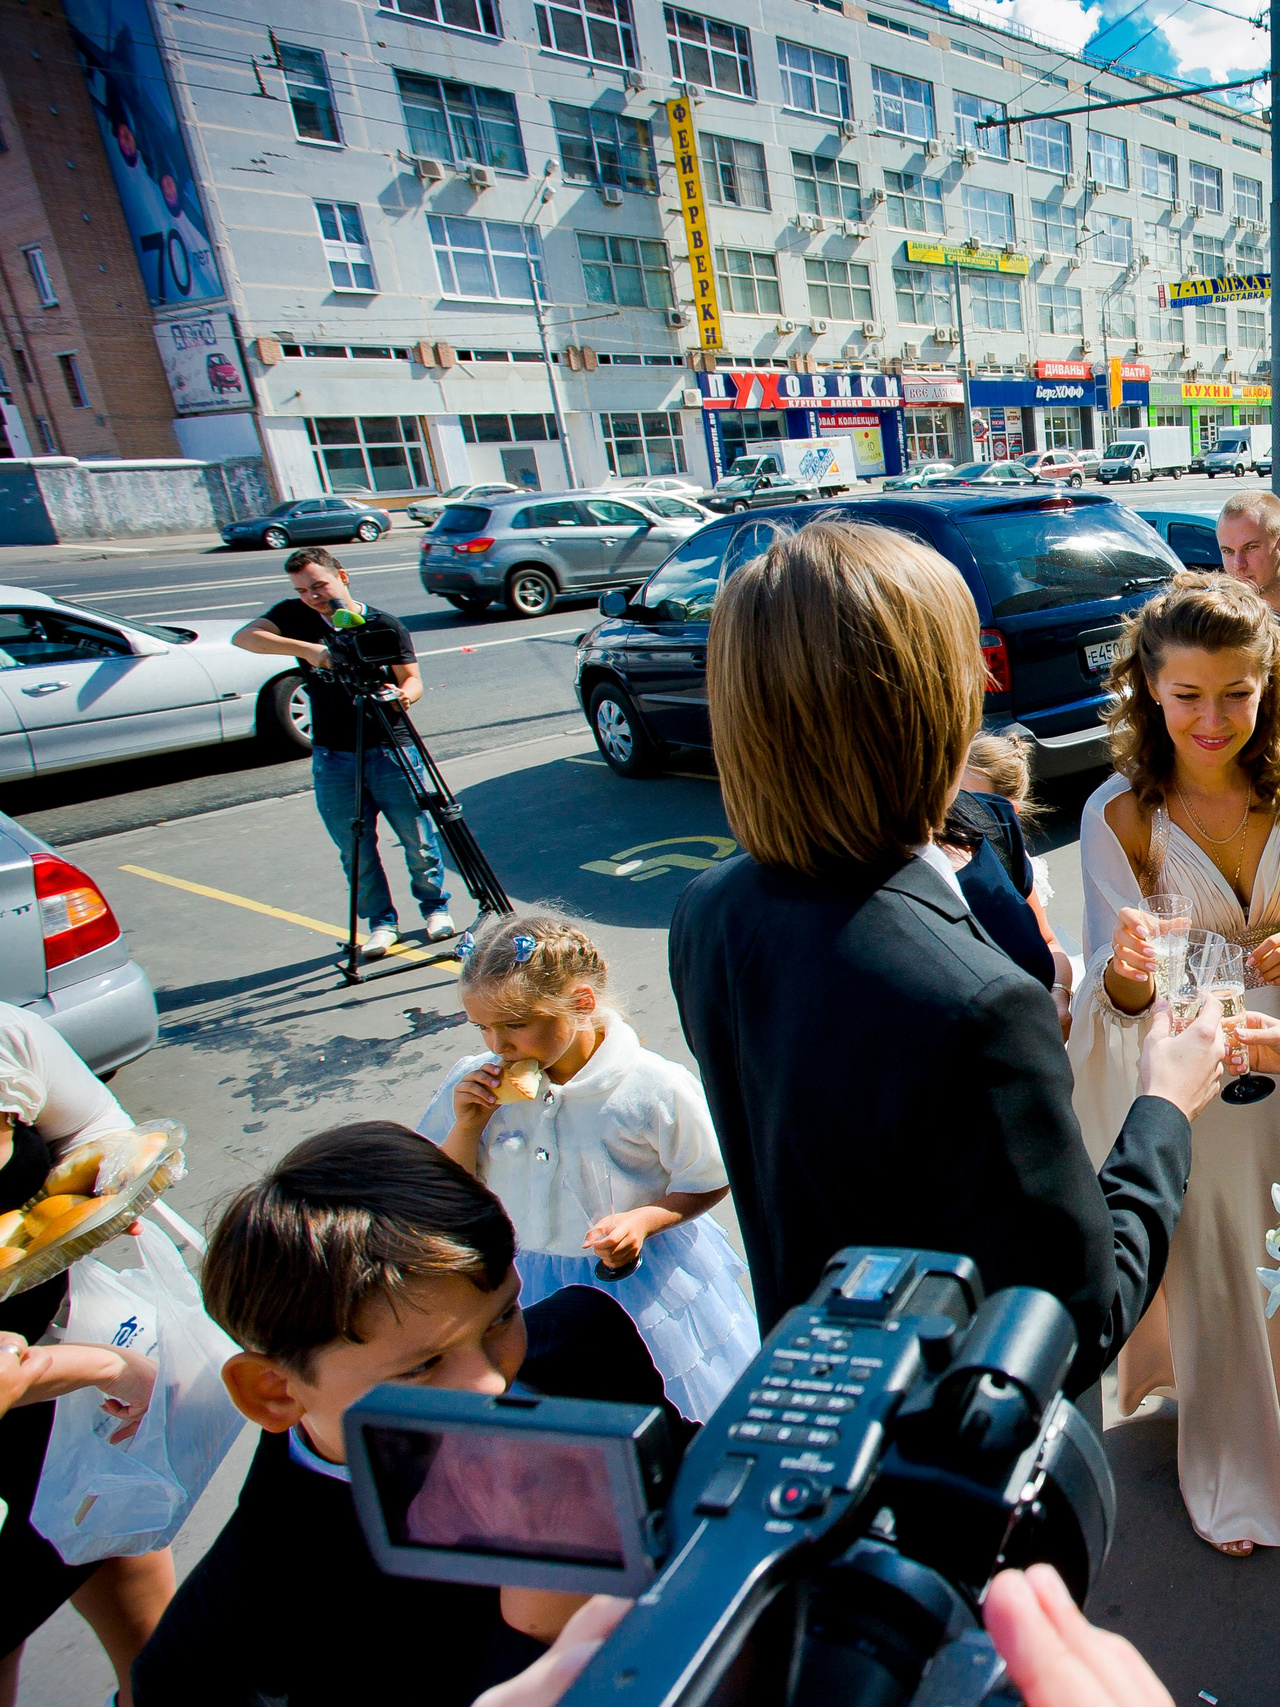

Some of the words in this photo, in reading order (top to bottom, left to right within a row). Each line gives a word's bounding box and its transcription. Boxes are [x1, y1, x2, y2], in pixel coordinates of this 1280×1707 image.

[672, 103, 717, 345] ФЕЙЕРВЕРКИ
[912, 242, 939, 251] ДВЕРИ
[941, 246, 973, 256] ПЛИТКА
[976, 251, 1004, 260] ПАРКЕТ
[140, 228, 192, 305] 70
[1217, 274, 1265, 294] МЕХА
[1215, 290, 1265, 303] ВЫСТАВКА
[1045, 363, 1085, 376] ДИВАНЫ
[1121, 366, 1146, 378] ОВАТИ
[707, 373, 899, 410] ПУХОВИКИ
[932, 387, 949, 399] ДЛЯ
[1185, 384, 1231, 398] КУХНИ
[788, 399, 823, 408] КУРТКИ
[870, 399, 900, 408] ПАЛЬТО
[819, 417, 836, 425] ОВАЯ
[838, 416, 880, 427] КОЛЛЕКЦИЯ
[708, 412, 723, 482] WW.PUHOVIK.RU
